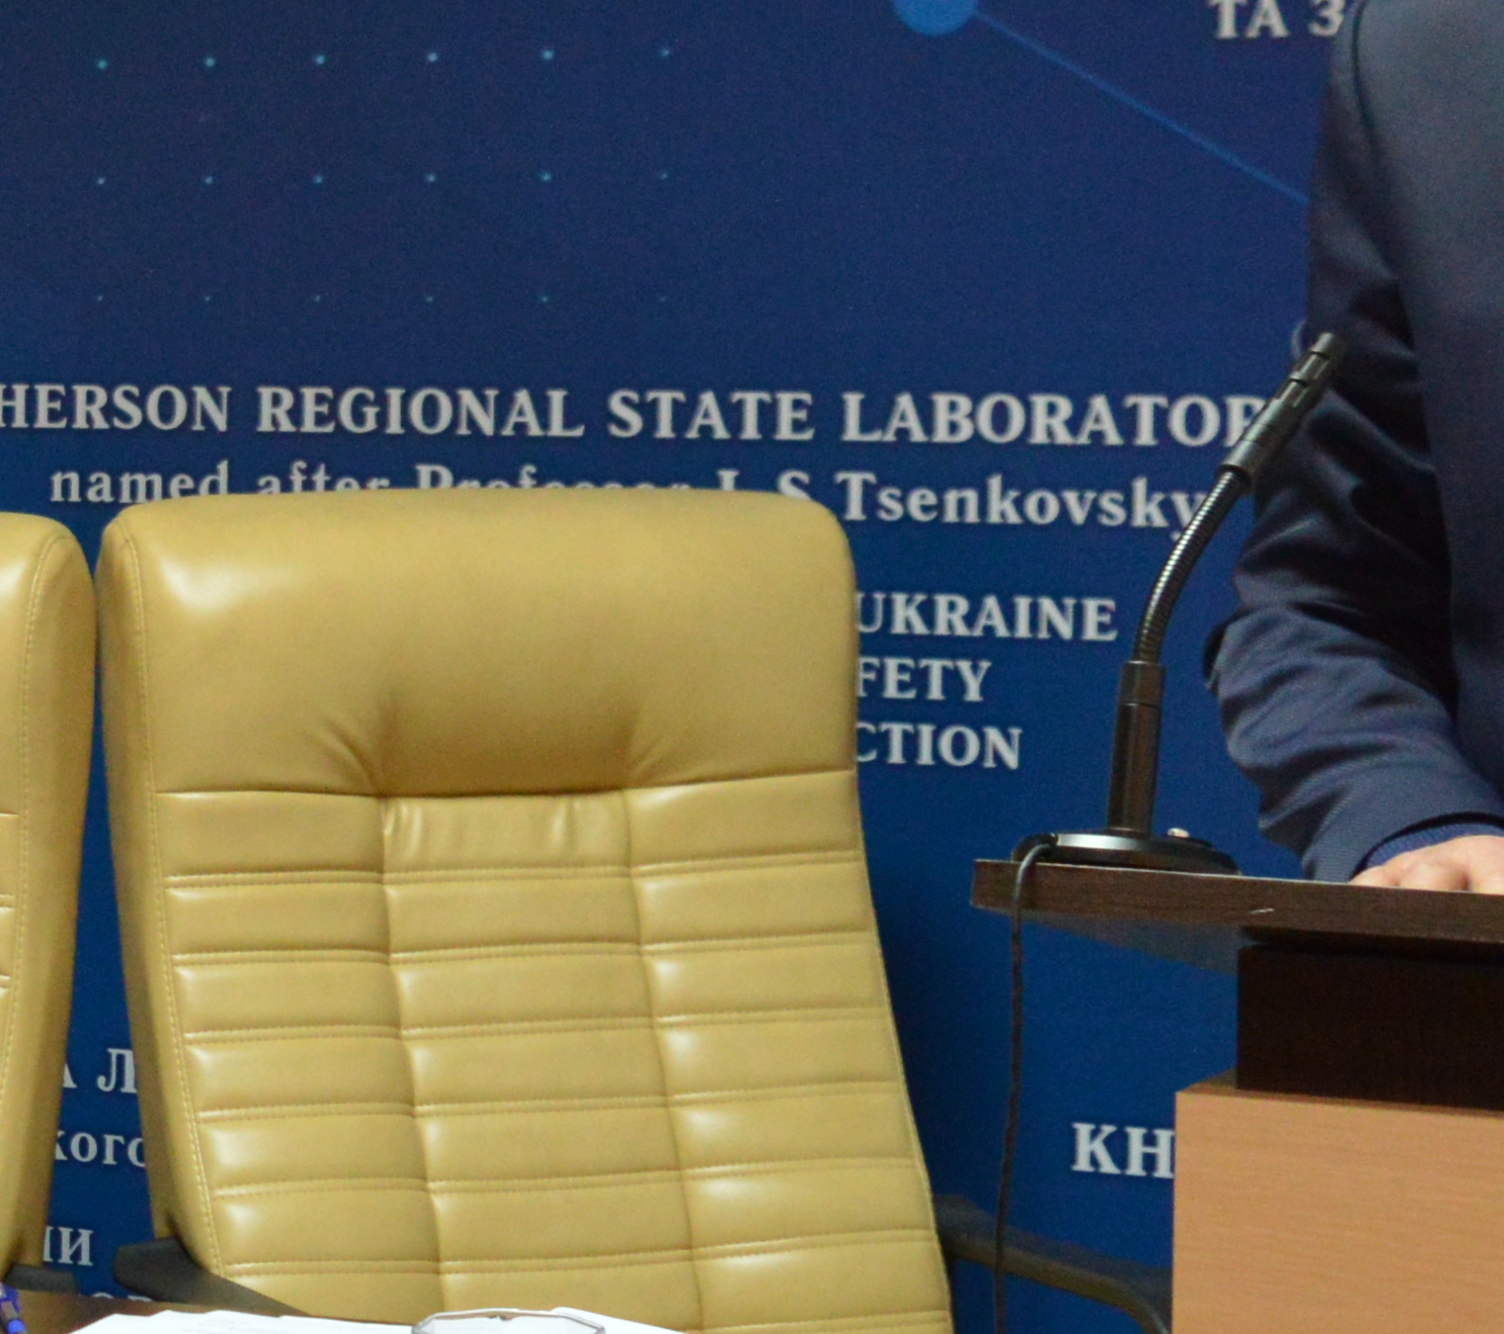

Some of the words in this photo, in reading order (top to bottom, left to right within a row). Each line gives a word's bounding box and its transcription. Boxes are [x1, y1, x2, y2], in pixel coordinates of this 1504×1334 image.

[255, 383, 586, 440] REGIONAL
[607, 387, 815, 443] STATE
[854, 591, 1119, 643] UKRAINE
